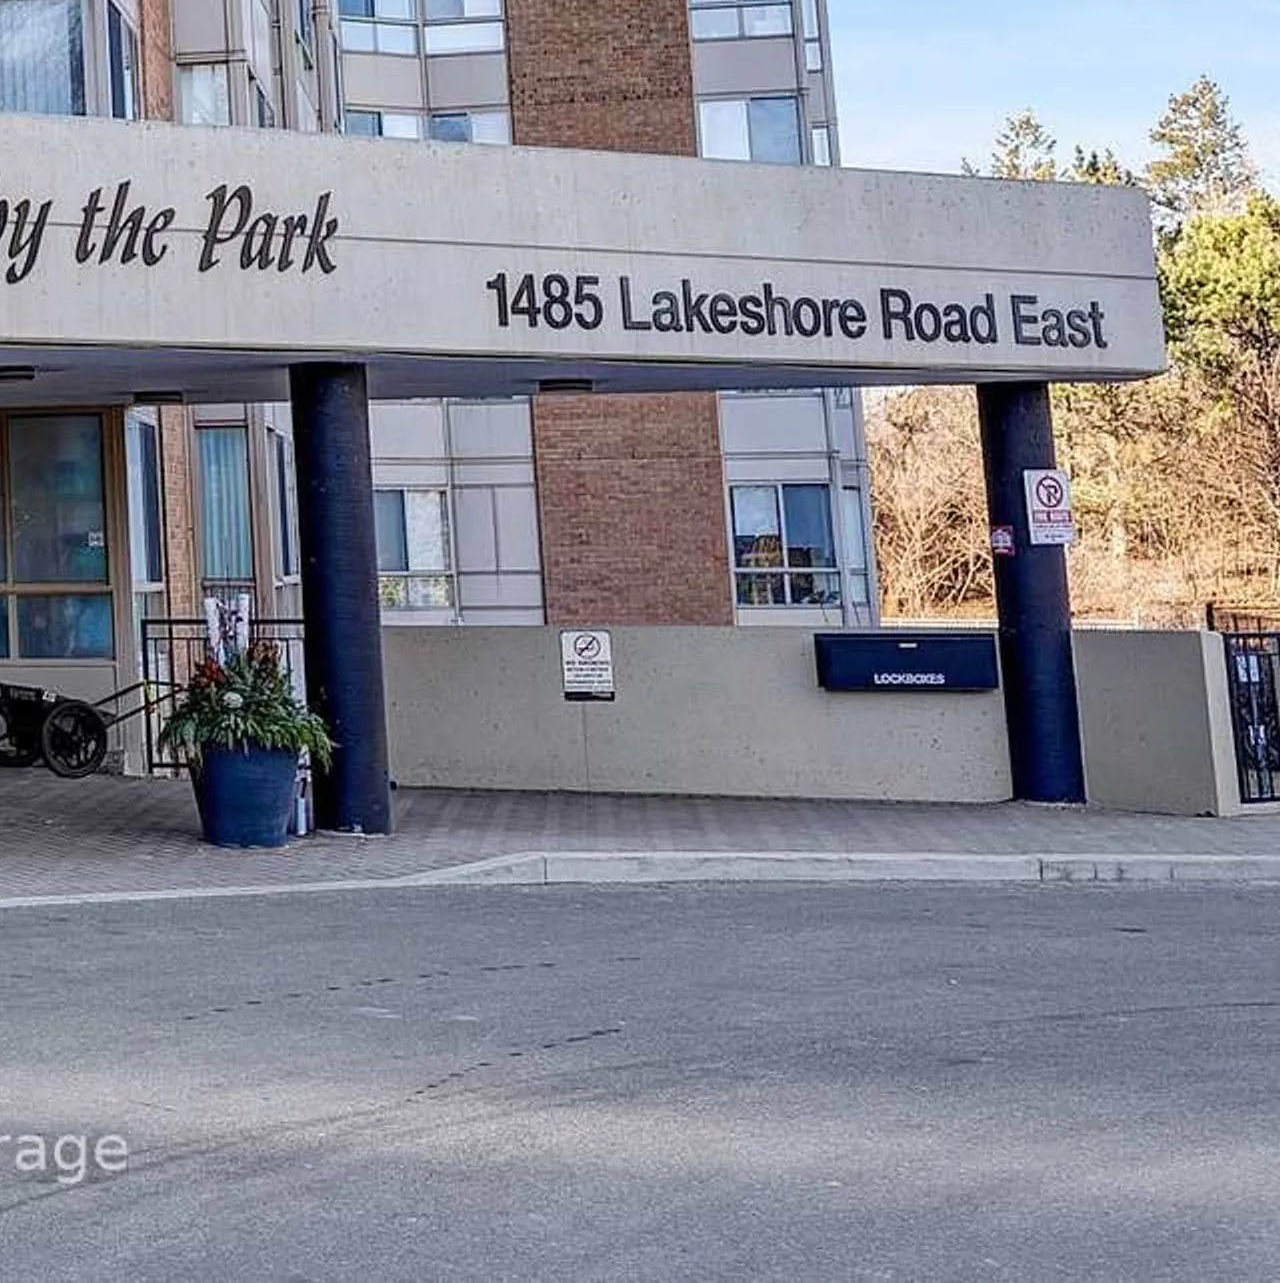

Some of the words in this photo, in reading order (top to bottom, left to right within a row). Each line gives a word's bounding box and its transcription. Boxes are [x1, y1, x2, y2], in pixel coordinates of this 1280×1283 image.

[73, 179, 177, 268] the
[197, 183, 341, 275] Park
[486, 272, 603, 331] 1485
[620, 276, 868, 339] Lakeshore
[879, 287, 999, 345] Road
[1010, 293, 1109, 349] East
[873, 672, 946, 685] LOCKBOXES
